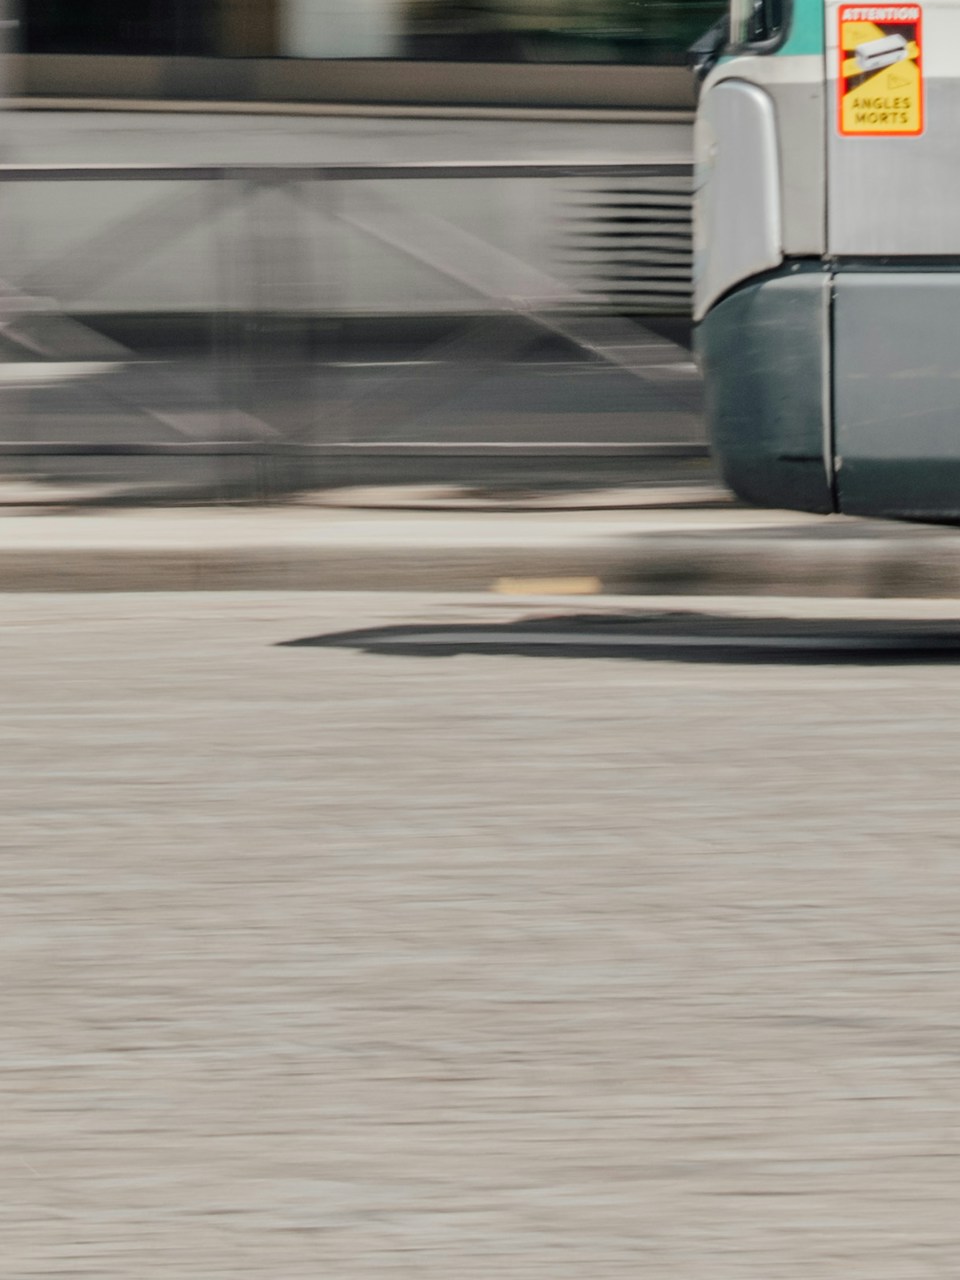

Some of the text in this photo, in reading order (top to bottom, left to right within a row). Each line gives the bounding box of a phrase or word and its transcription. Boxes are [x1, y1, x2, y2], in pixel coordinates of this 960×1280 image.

[842, 7, 920, 20] ATTENTION
[852, 97, 911, 110] ANGLES
[854, 111, 908, 124] MORTS
